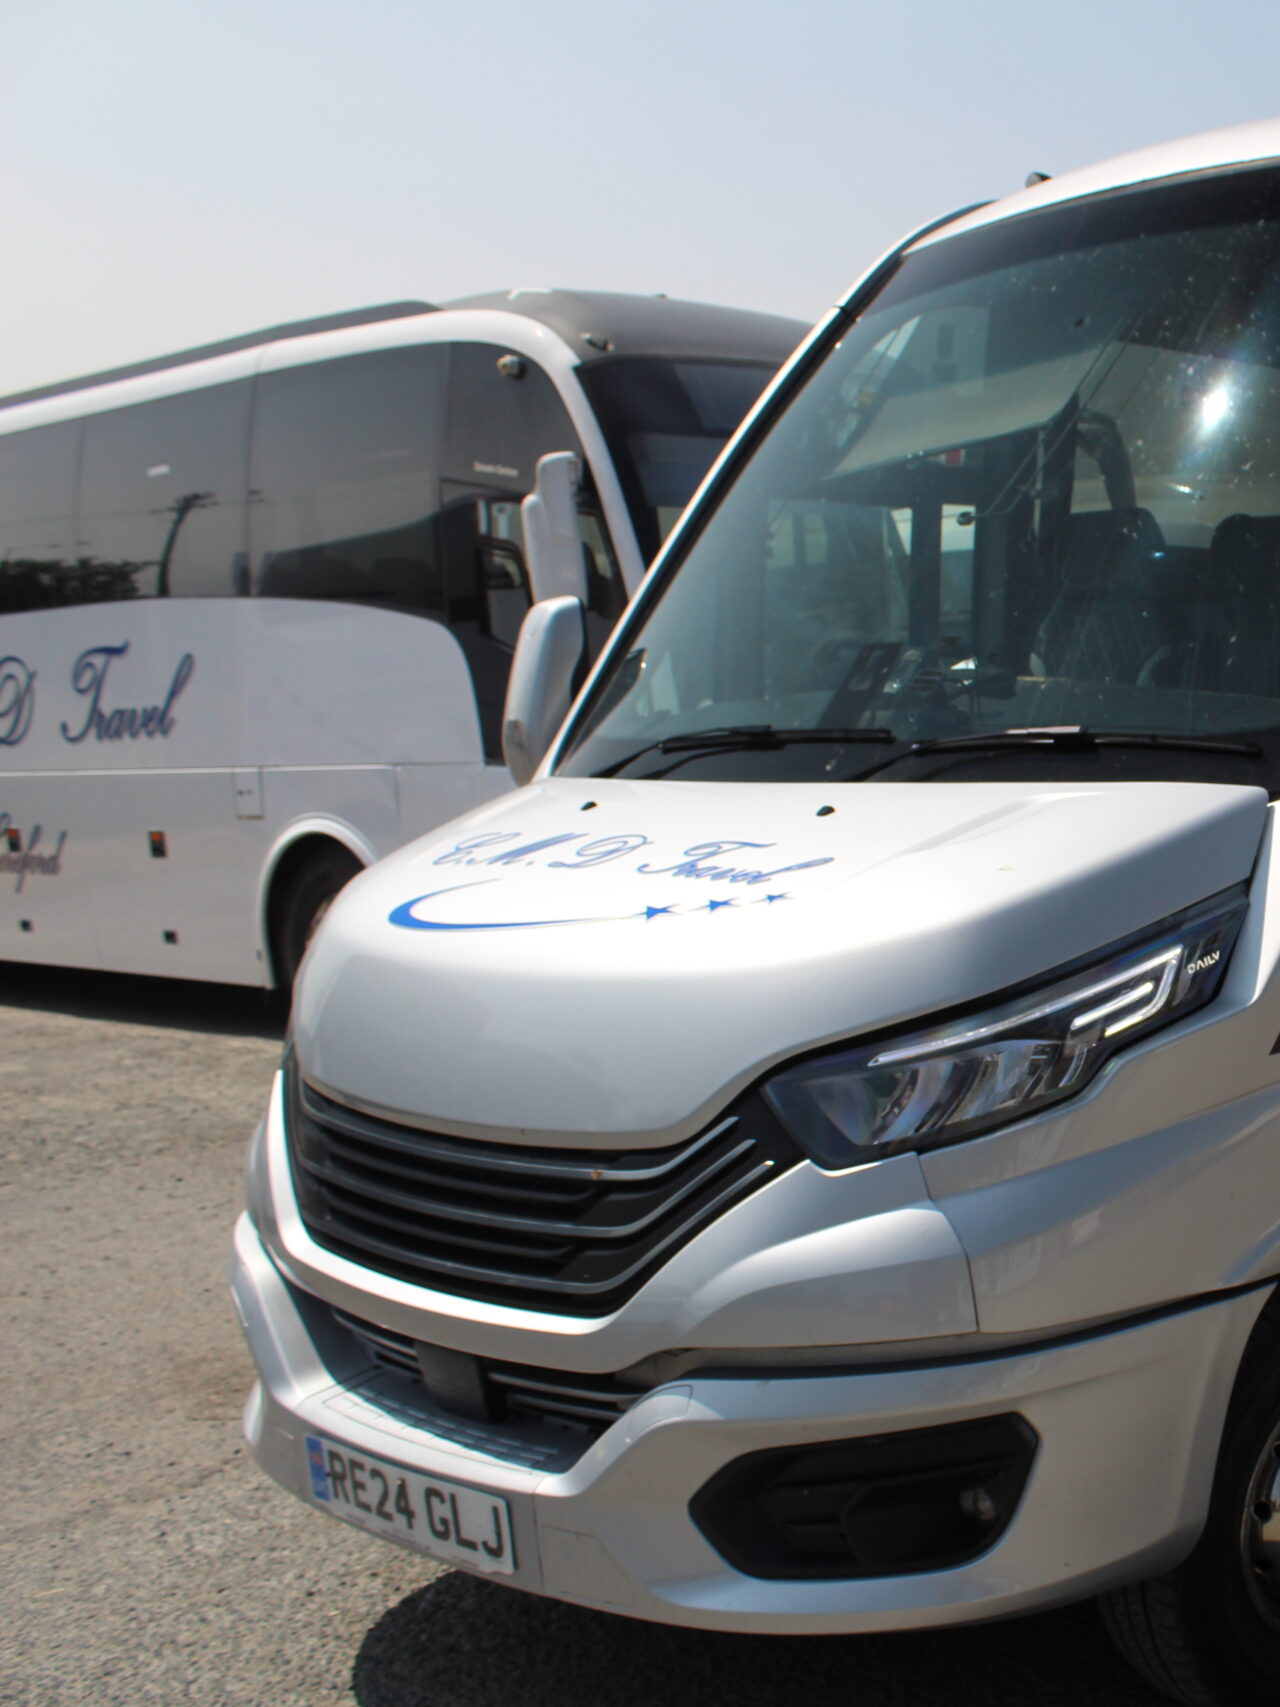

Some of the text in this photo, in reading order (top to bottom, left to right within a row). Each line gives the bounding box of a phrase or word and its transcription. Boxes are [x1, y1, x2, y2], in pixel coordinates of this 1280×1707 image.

[60, 640, 195, 744] Travel
[636, 841, 835, 885] Travel
[326, 1450, 504, 1559] RE24 GLJ
